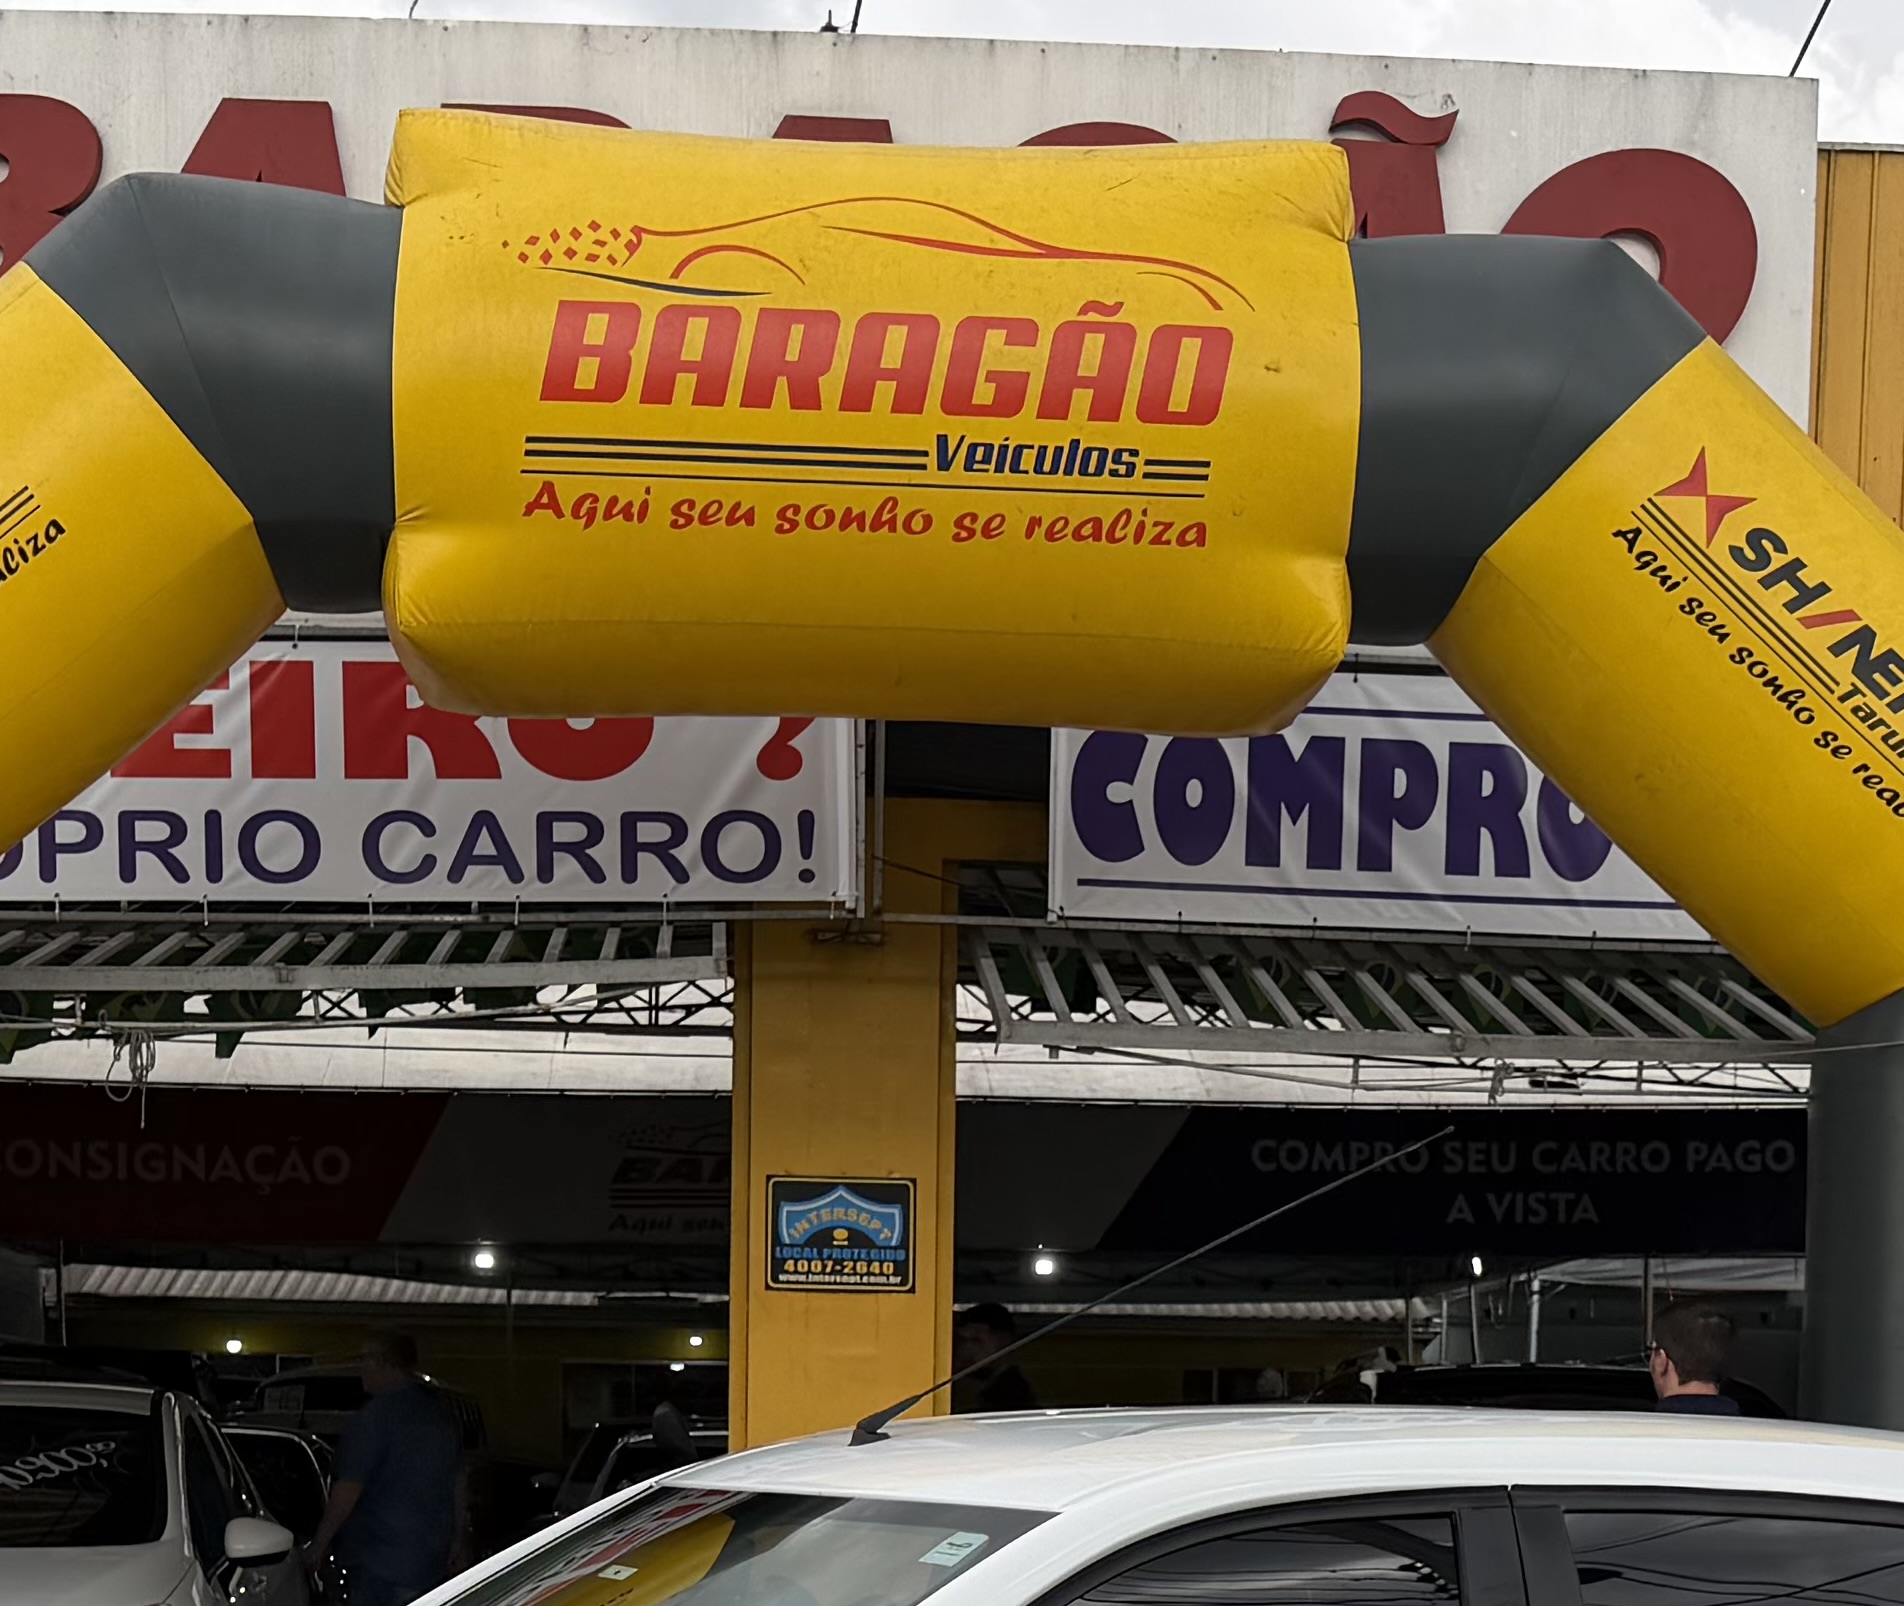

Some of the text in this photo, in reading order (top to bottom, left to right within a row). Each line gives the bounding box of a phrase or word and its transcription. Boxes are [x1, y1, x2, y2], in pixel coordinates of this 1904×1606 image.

[540, 299, 1234, 426] BARAGÃO
[521, 480, 1209, 549] Aqui seu sonho se realiza
[1611, 525, 1689, 595] Aqui
[1678, 596, 1733, 646] seu
[1729, 645, 1817, 727] sonho
[1813, 729, 1853, 762] se
[362, 808, 816, 885] CARRO!
[1249, 1138, 1795, 1175] COMPRO SEU CARRO PAGO
[1446, 1193, 1600, 1224] A VISTA
[775, 1247, 818, 1259] LOCAL
